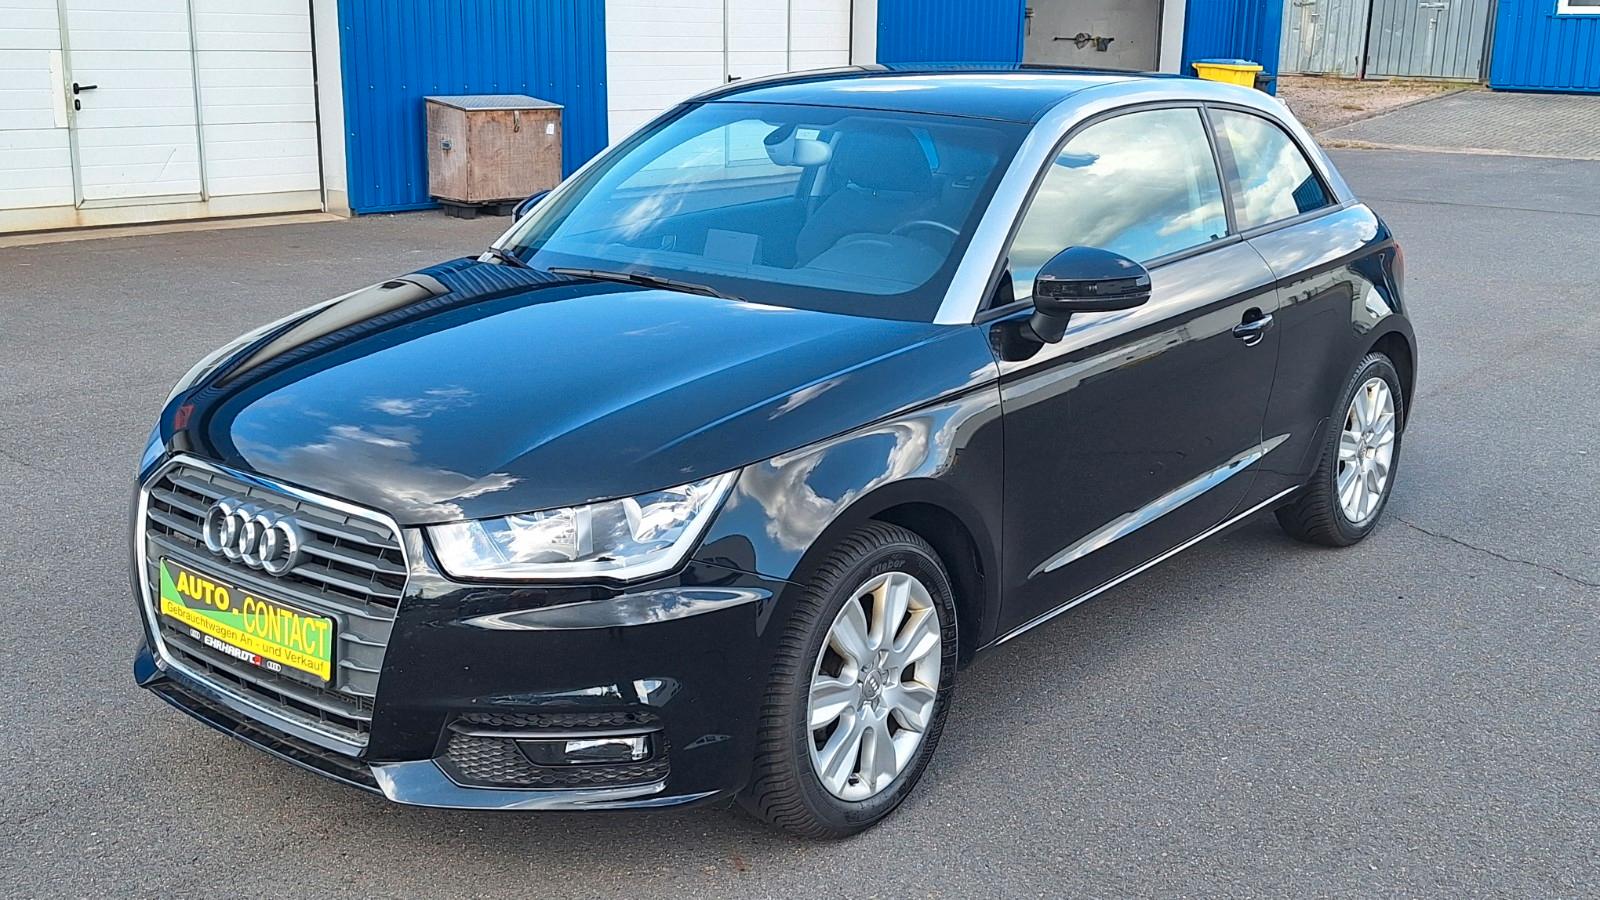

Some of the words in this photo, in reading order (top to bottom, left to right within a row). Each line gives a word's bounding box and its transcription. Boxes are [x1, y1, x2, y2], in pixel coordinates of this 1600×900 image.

[167, 601, 238, 639] Gebrauchtwagen
[240, 633, 253, 647] An
[262, 643, 282, 657] und
[284, 649, 324, 671] Verkauf
[204, 634, 256, 664] EHRHARDT
